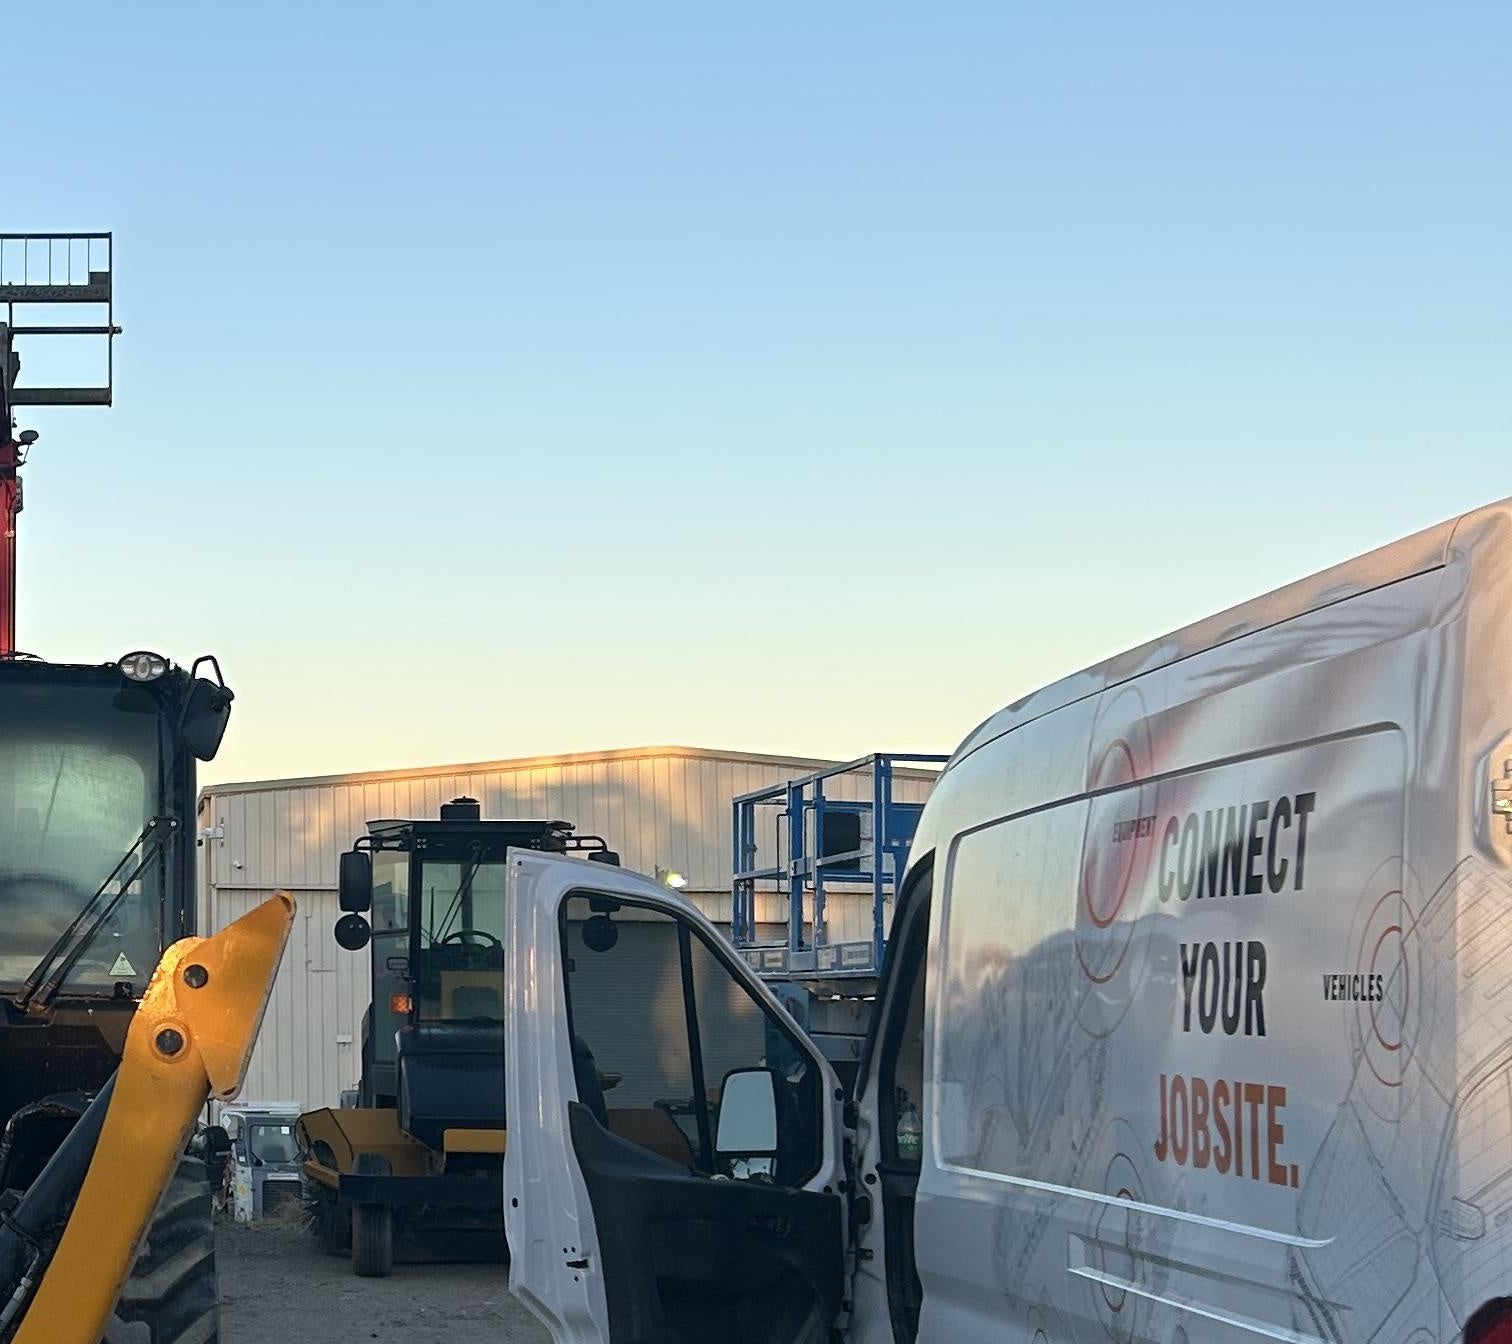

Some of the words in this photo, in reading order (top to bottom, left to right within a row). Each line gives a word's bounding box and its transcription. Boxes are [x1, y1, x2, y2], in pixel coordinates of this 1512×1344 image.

[1158, 792, 1317, 903] CONNECT
[1179, 941, 1267, 1037] YOUR
[1323, 974, 1383, 1002] VEHICLES
[1153, 1073, 1299, 1189] JOBSITE.
